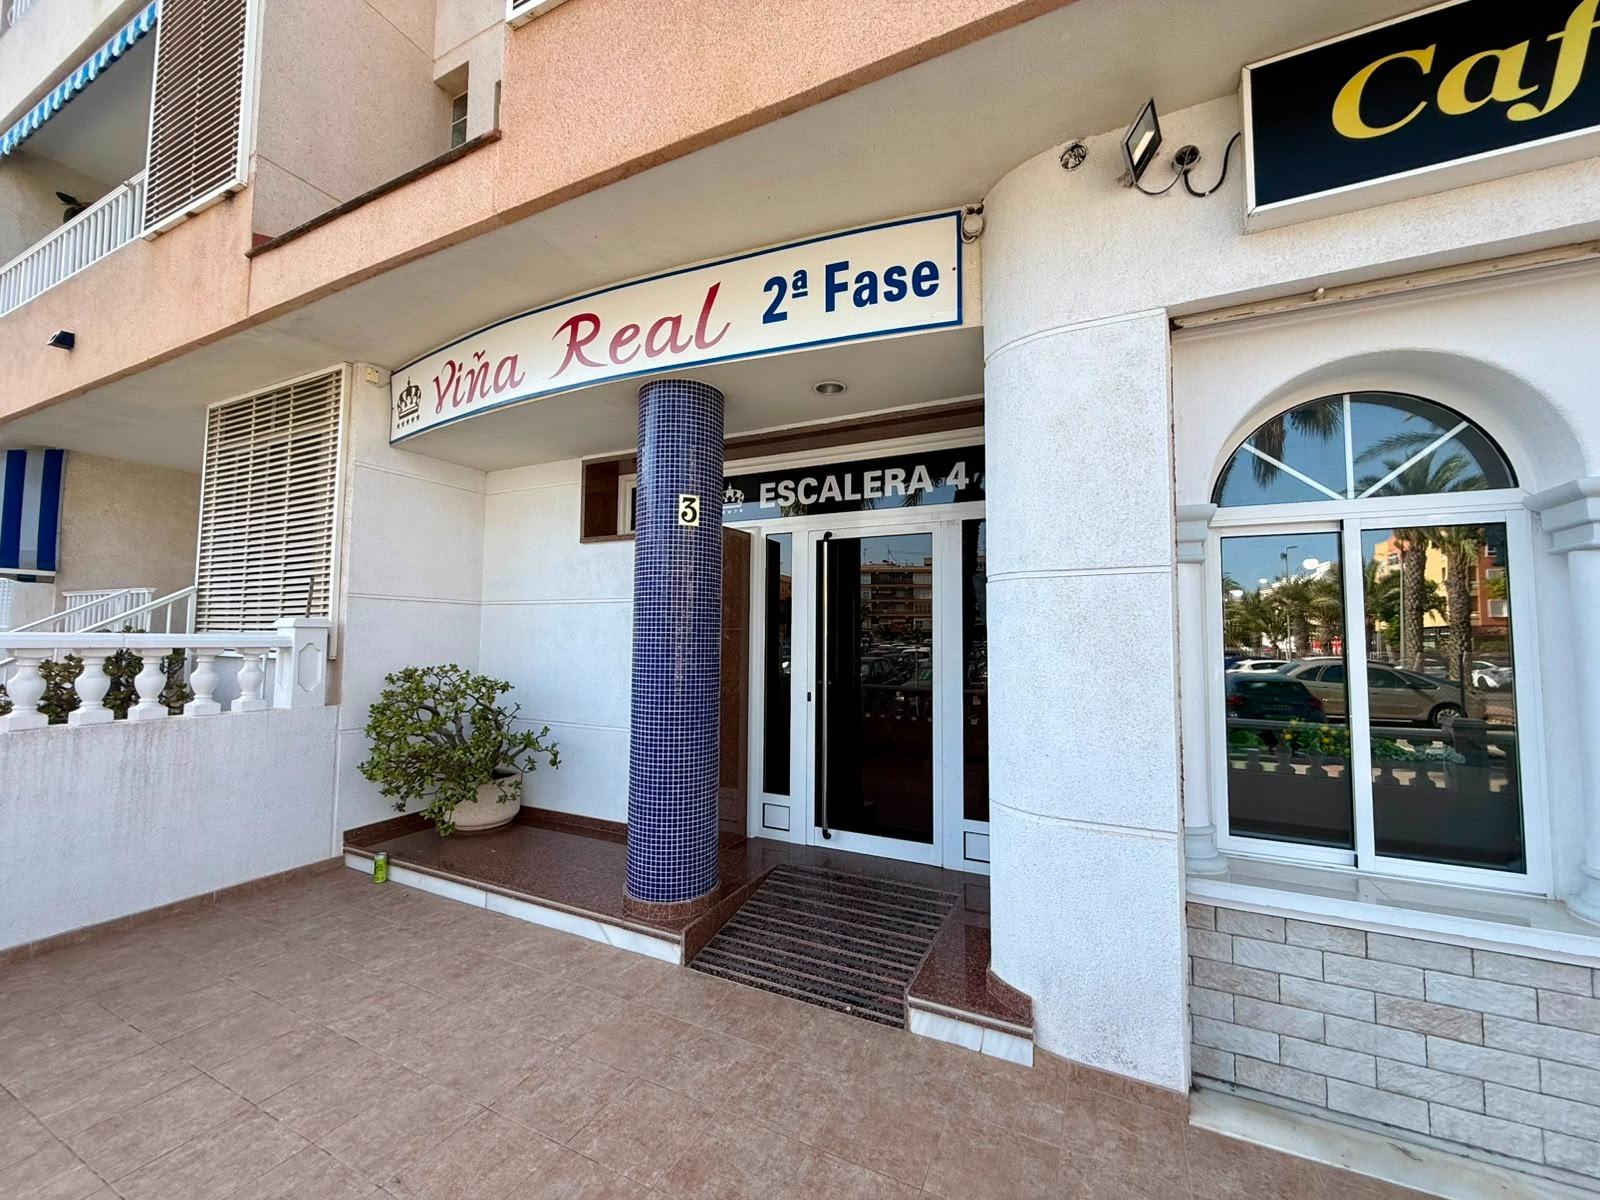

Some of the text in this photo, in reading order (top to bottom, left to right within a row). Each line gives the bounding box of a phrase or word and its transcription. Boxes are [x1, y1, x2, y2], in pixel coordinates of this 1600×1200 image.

[432, 259, 940, 414] Viña Real 2ª Fase
[759, 461, 969, 508] ESCALERA 4
[681, 497, 697, 523] 3
